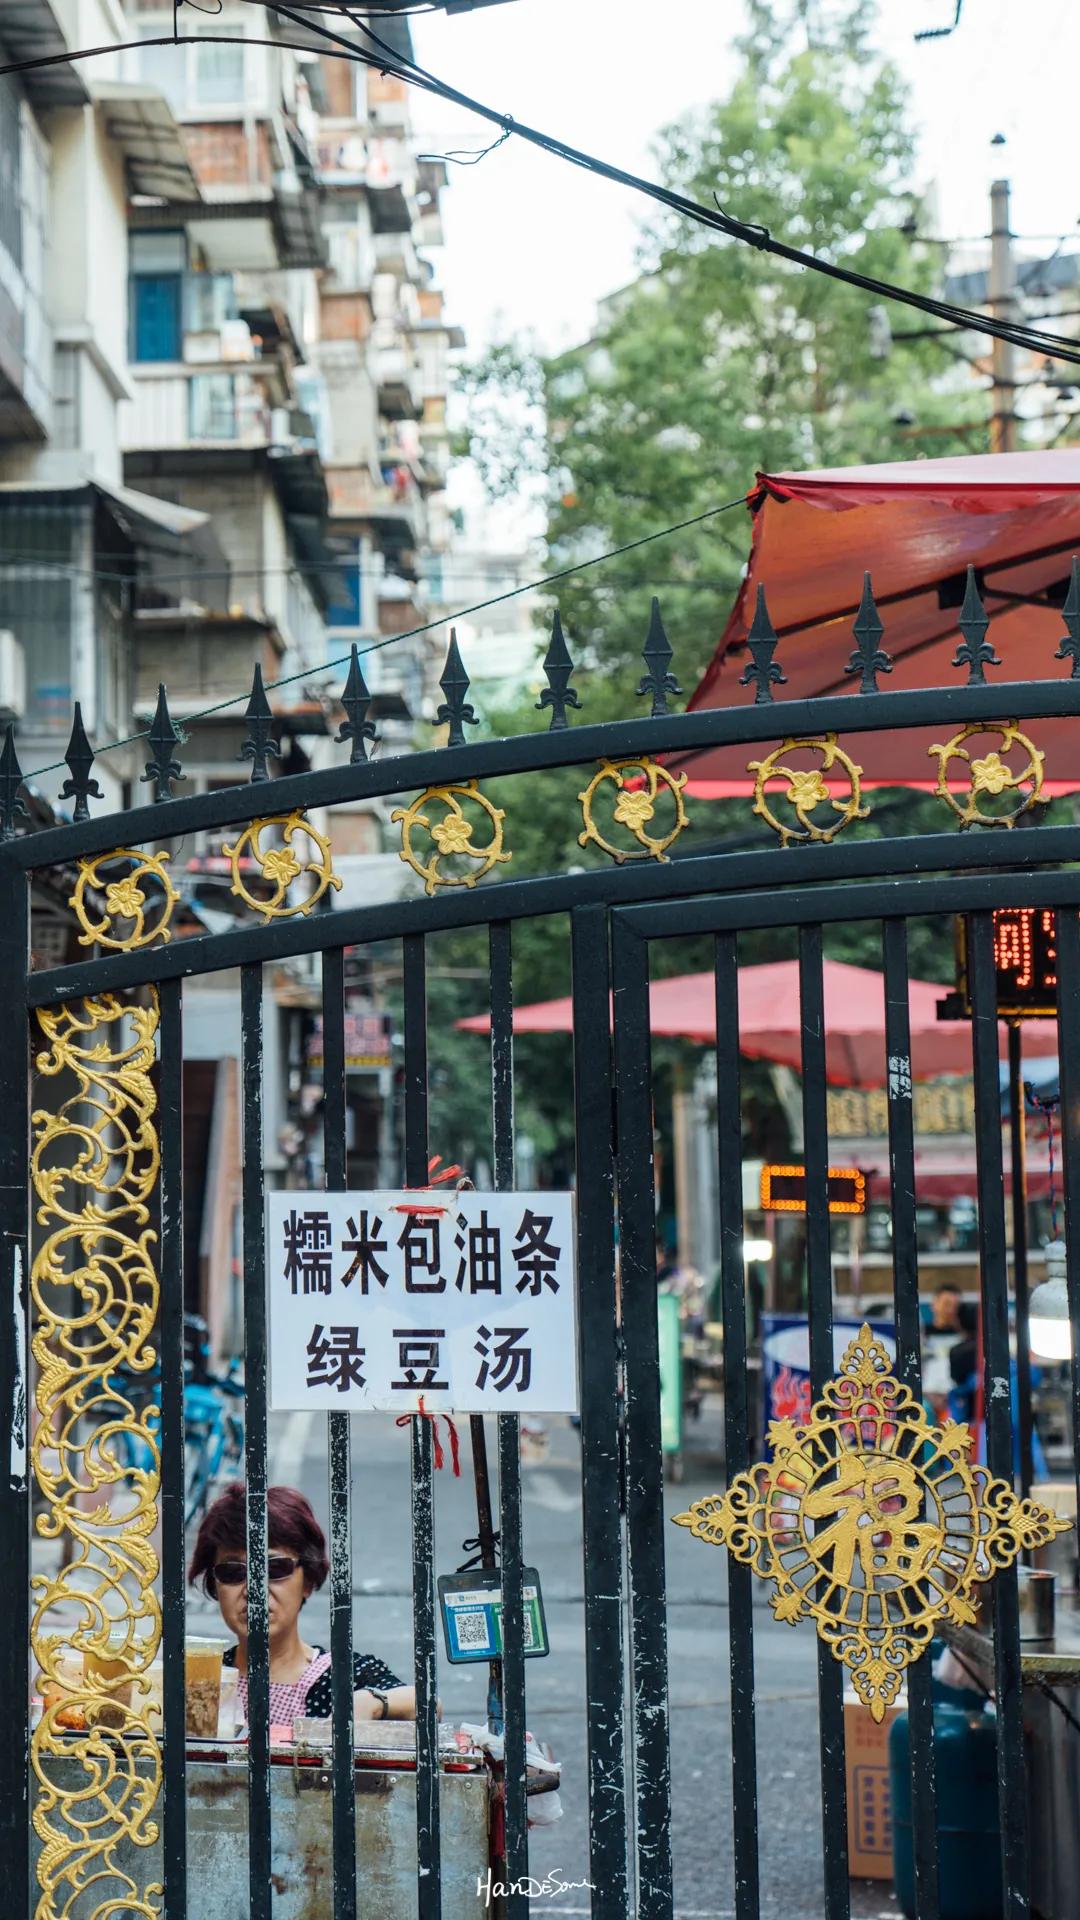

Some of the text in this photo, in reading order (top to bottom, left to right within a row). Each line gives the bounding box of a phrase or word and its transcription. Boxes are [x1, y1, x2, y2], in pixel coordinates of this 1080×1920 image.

[282, 1208, 562, 1297] 糯米包油条
[305, 1324, 532, 1393] 绿豆汤
[803, 1454, 945, 1591] 福
